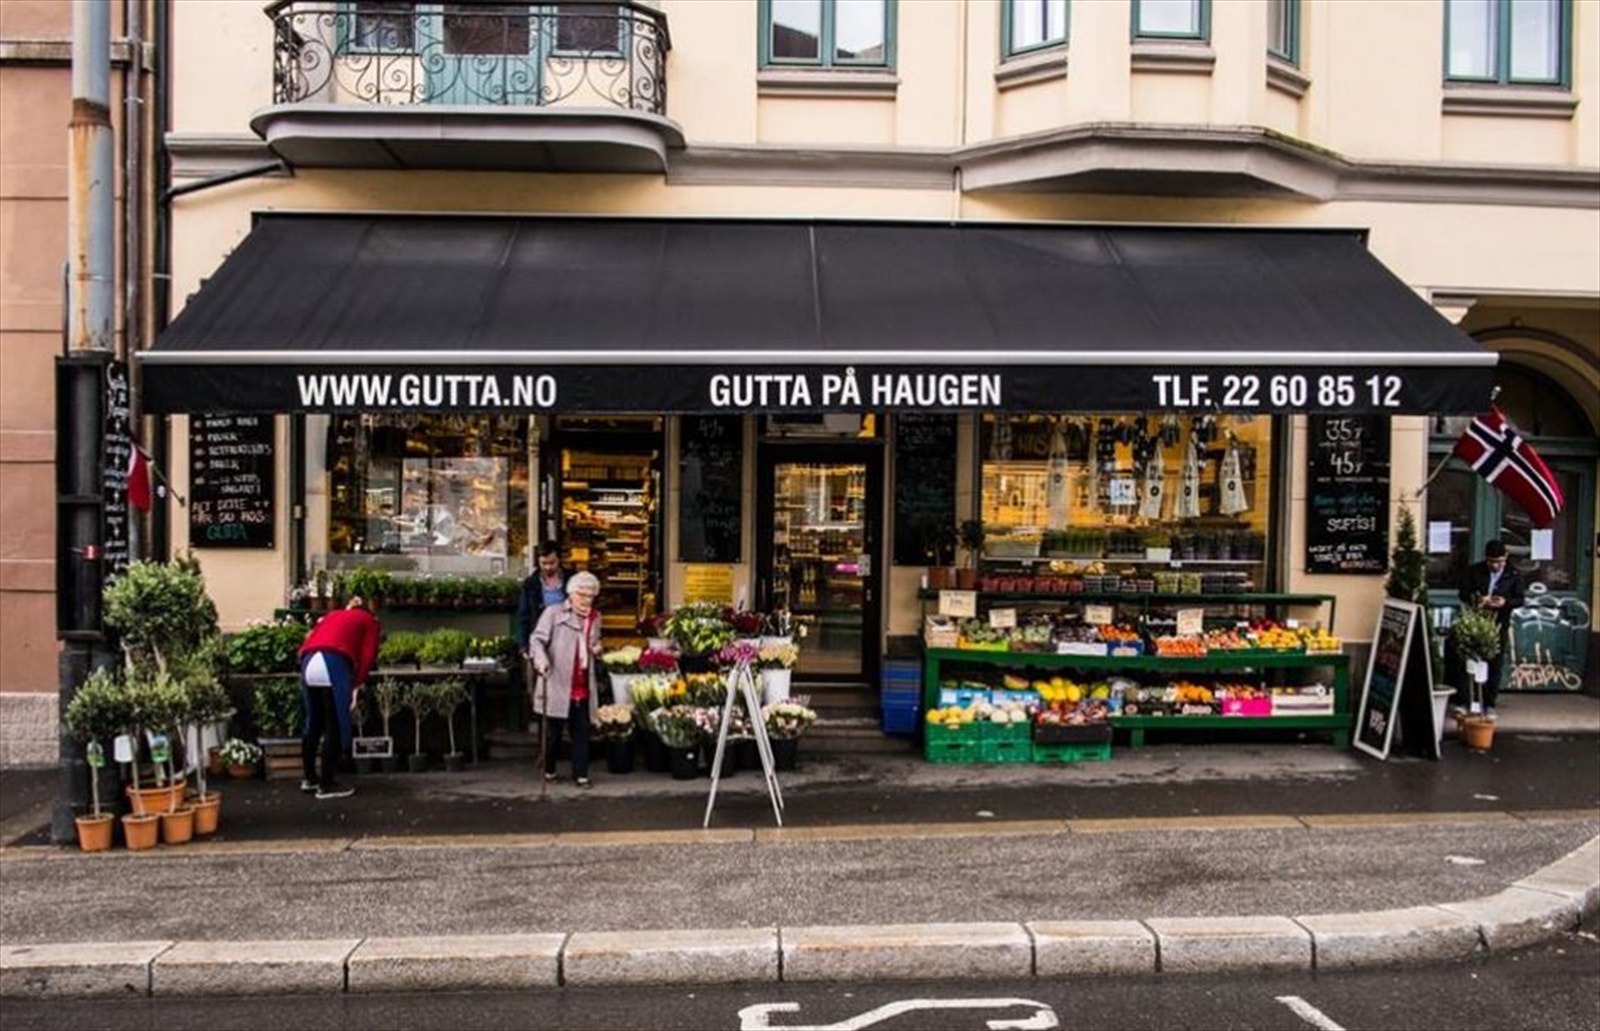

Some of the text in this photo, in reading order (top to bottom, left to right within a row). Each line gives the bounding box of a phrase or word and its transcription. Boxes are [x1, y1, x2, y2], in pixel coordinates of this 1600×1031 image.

[297, 374, 557, 407] WWW.GUTTA.NO
[709, 366, 1002, 407] GUTTA PÅ HAUGEN
[1152, 374, 1402, 407] TLF. 22 60 85 12
